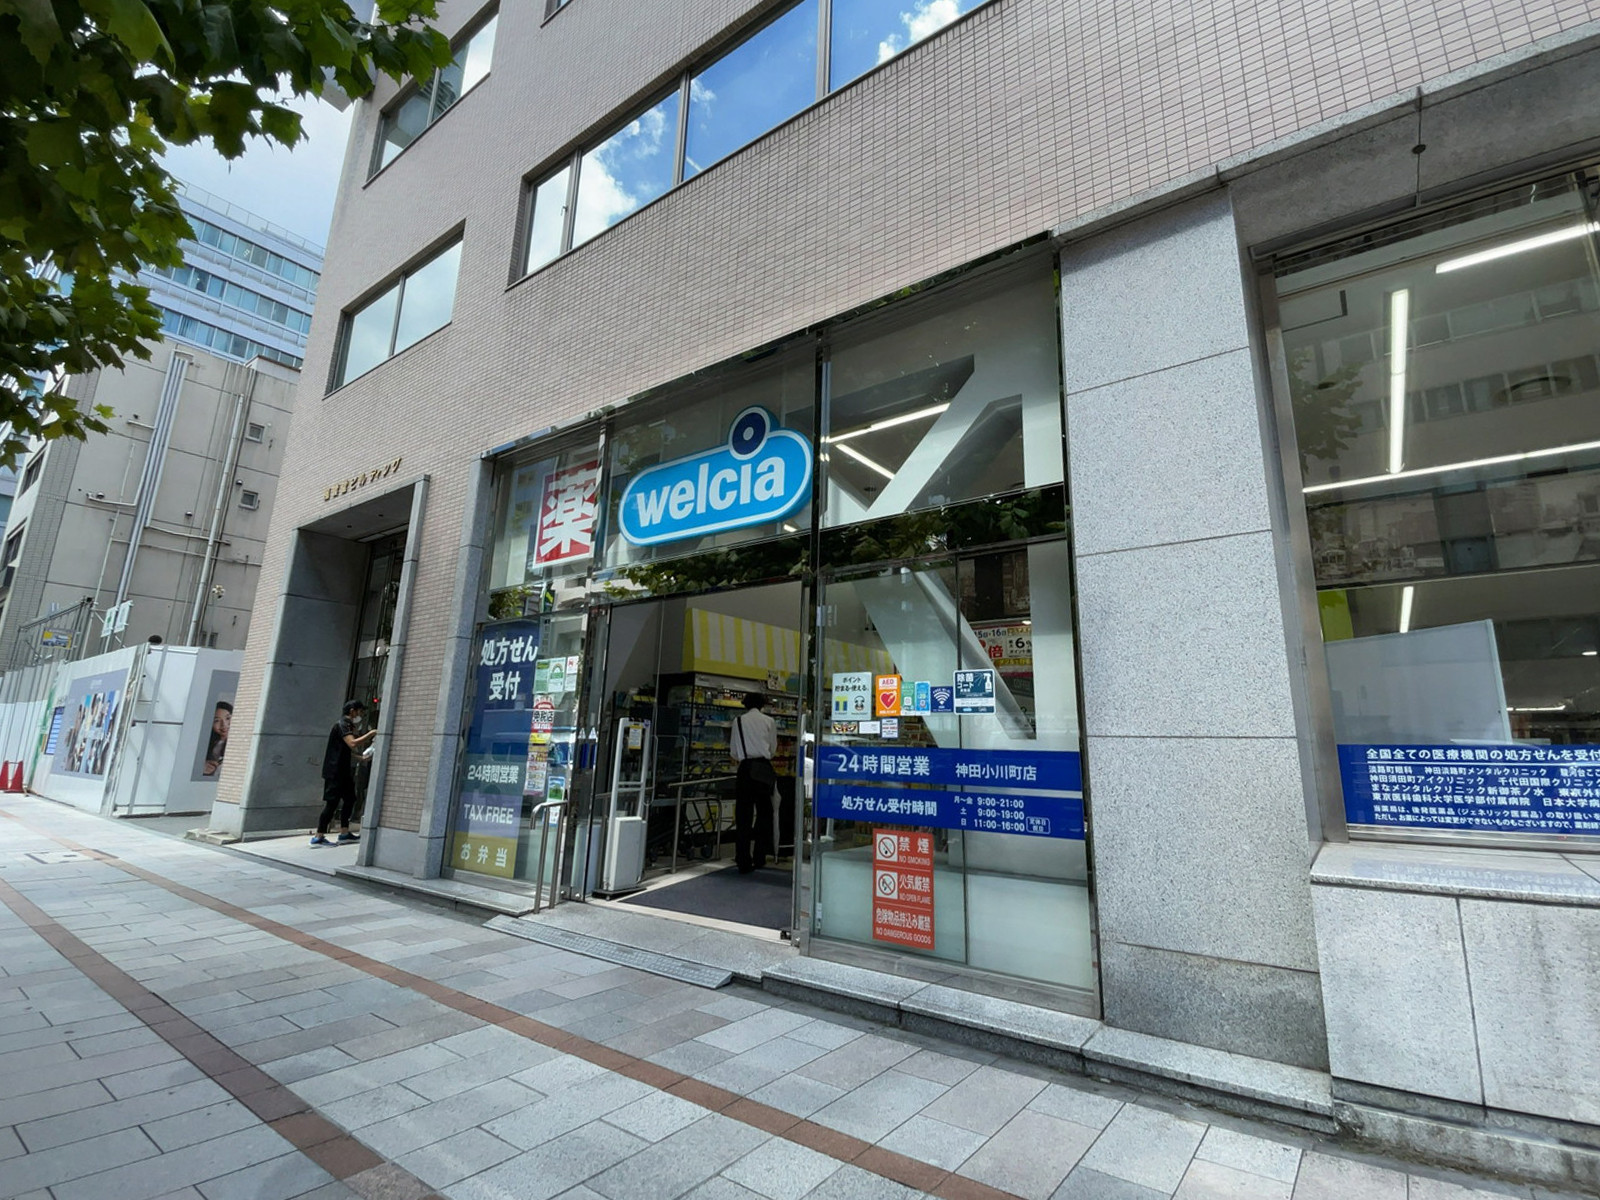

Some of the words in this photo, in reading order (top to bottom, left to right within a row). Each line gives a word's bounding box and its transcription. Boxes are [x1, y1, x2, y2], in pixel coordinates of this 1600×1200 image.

[636, 456, 786, 528] welcia
[539, 467, 599, 558] 薬
[480, 635, 538, 666] 処方せん
[988, 644, 1003, 659] 倍
[489, 671, 521, 701] 受付
[957, 672, 974, 682] 除菌
[1366, 748, 1600, 761] 全国全ての医療機関の処方せんを受付
[467, 765, 519, 784] 24時間営業
[837, 753, 930, 776] 24時間営業
[955, 763, 1037, 781] 神田小川町店
[464, 804, 484, 821] TAX
[485, 806, 514, 825] FREE
[841, 795, 937, 817] 処方せん受付時間
[960, 807, 967, 815] 土
[960, 818, 967, 826] 日
[899, 836, 930, 854] 禁煙
[460, 843, 508, 868] お弁当
[899, 855, 907, 863] NO
[907, 856, 930, 866] SMOKING
[899, 874, 931, 893] 火気厳禁
[899, 892, 906, 901] NO
[875, 926, 883, 936] NO
[883, 928, 913, 941] DANGEROUS
[913, 933, 931, 944] GOODS
